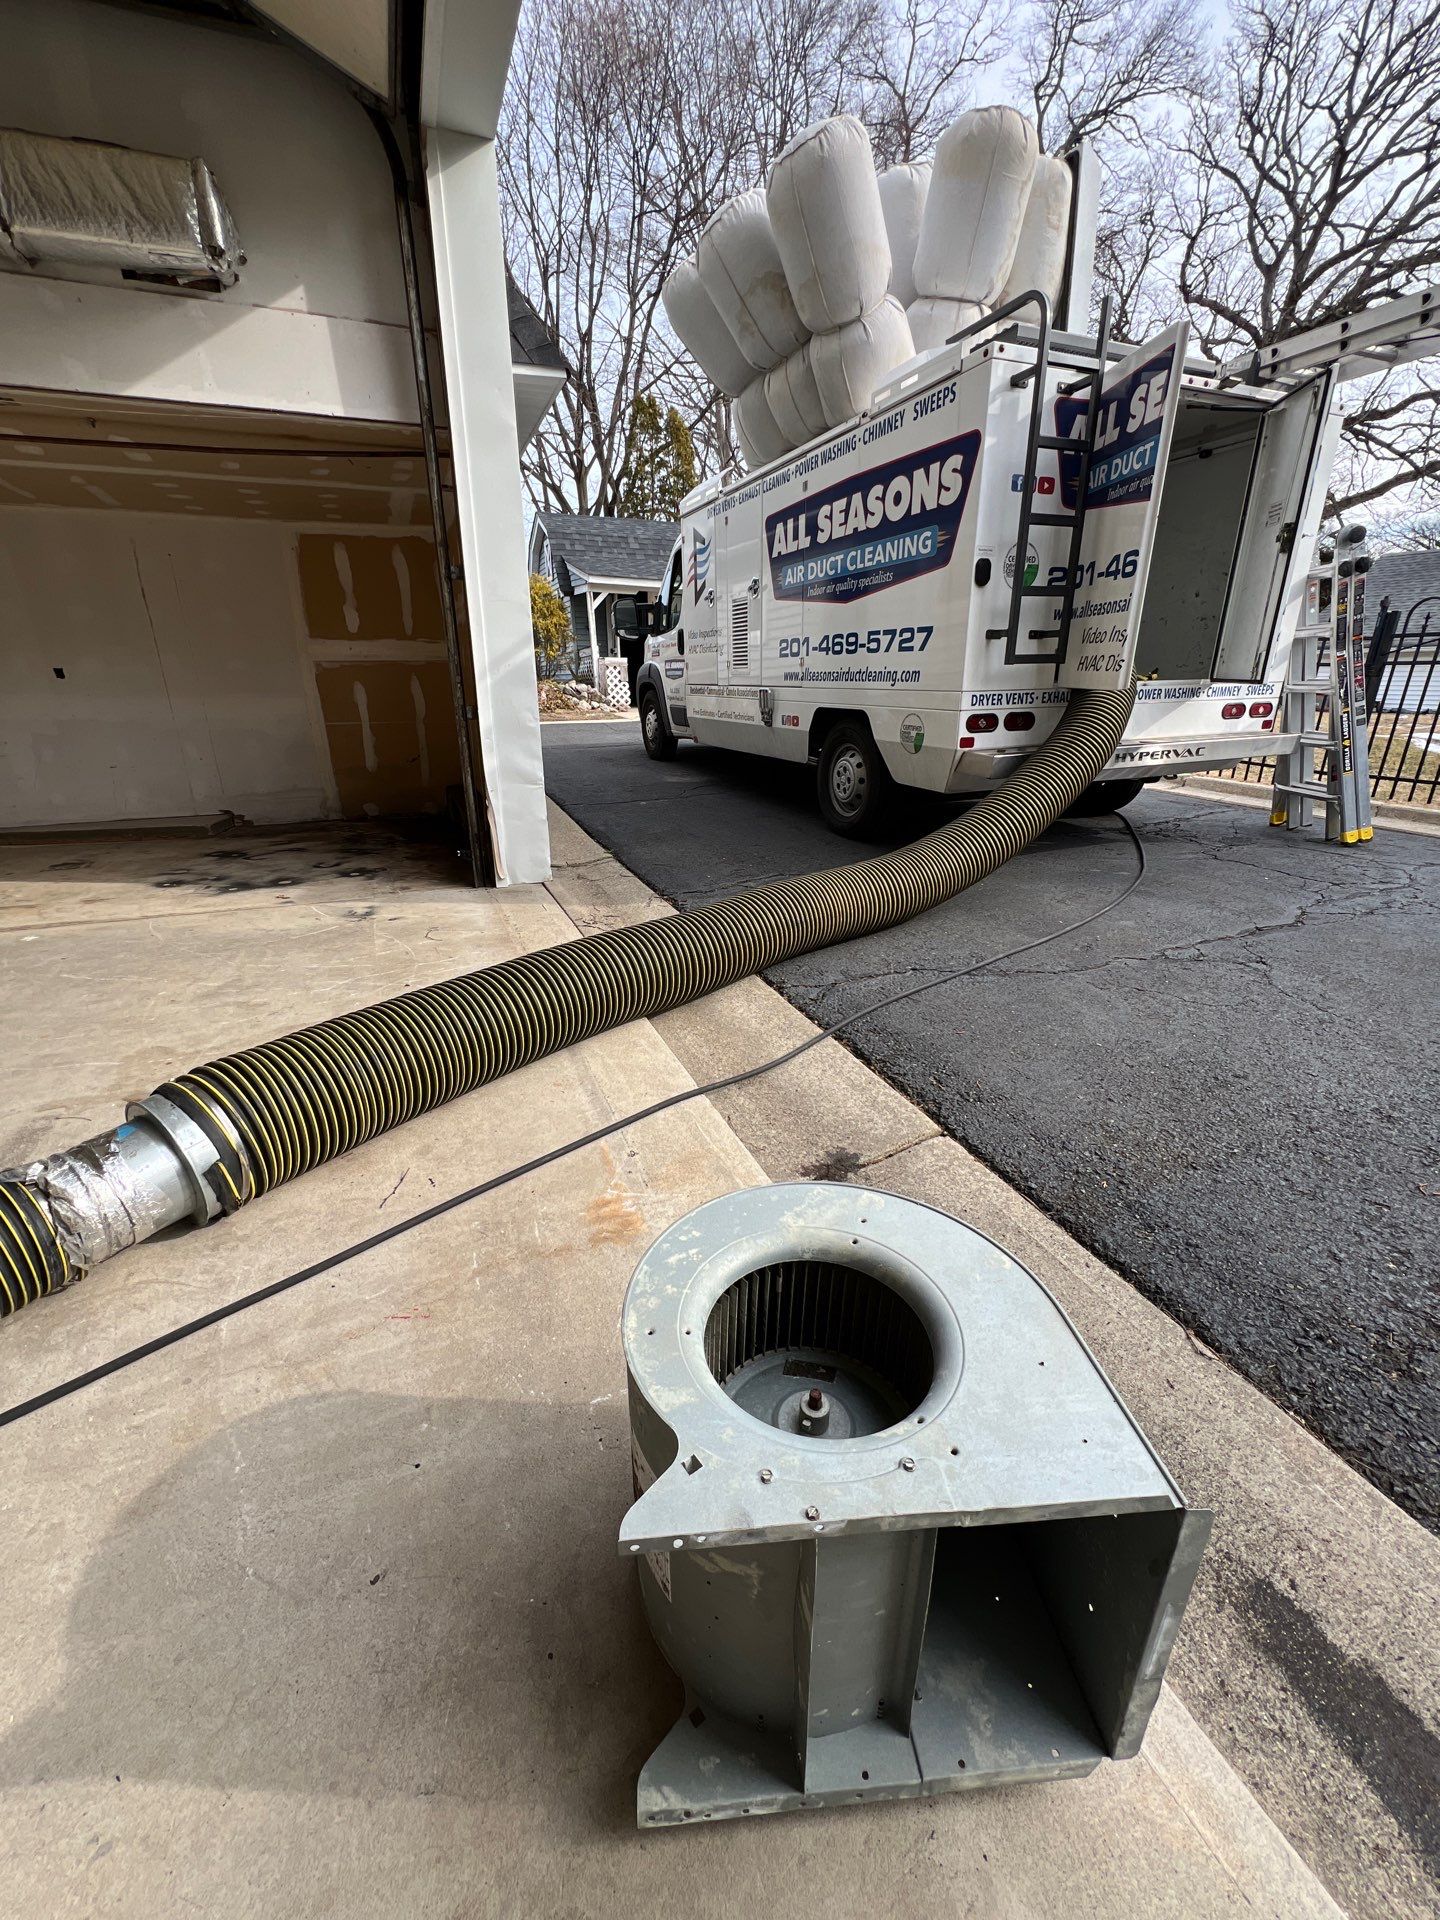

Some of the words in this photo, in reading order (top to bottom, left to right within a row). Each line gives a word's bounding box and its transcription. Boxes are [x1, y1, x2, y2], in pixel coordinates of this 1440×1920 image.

[762, 468, 791, 494] CLEANING
[794, 459, 819, 479] POWER
[820, 437, 857, 468] WASHING
[862, 409, 906, 446] CHIMNEY
[913, 382, 957, 421] SWEEPS
[1110, 441, 1154, 480] DUCT
[772, 514, 812, 558] ALL
[816, 454, 964, 544] SEASONS
[785, 565, 804, 586] AIR
[807, 554, 844, 580] DUCT
[846, 531, 932, 570] CLEANING
[807, 584, 825, 597] Indoor
[826, 583, 835, 594] air
[835, 577, 857, 592] quality
[858, 571, 893, 589] specialists
[779, 625, 933, 658] 201-469-5727
[1081, 627, 1107, 644] Video
[1077, 655, 1105, 672] HVAC
[783, 667, 921, 686] www.allseasonsairductcleaning.com
[971, 693, 1003, 706] DRYER
[1005, 692, 1035, 705] VENTS
[1136, 688, 1162, 700] OWER
[1164, 687, 1201, 699] WASHING
[1206, 685, 1242, 698] CHIMNEY
[1245, 683, 1275, 696] SWEEPS
[1114, 747, 1206, 763] HYPERVAC
